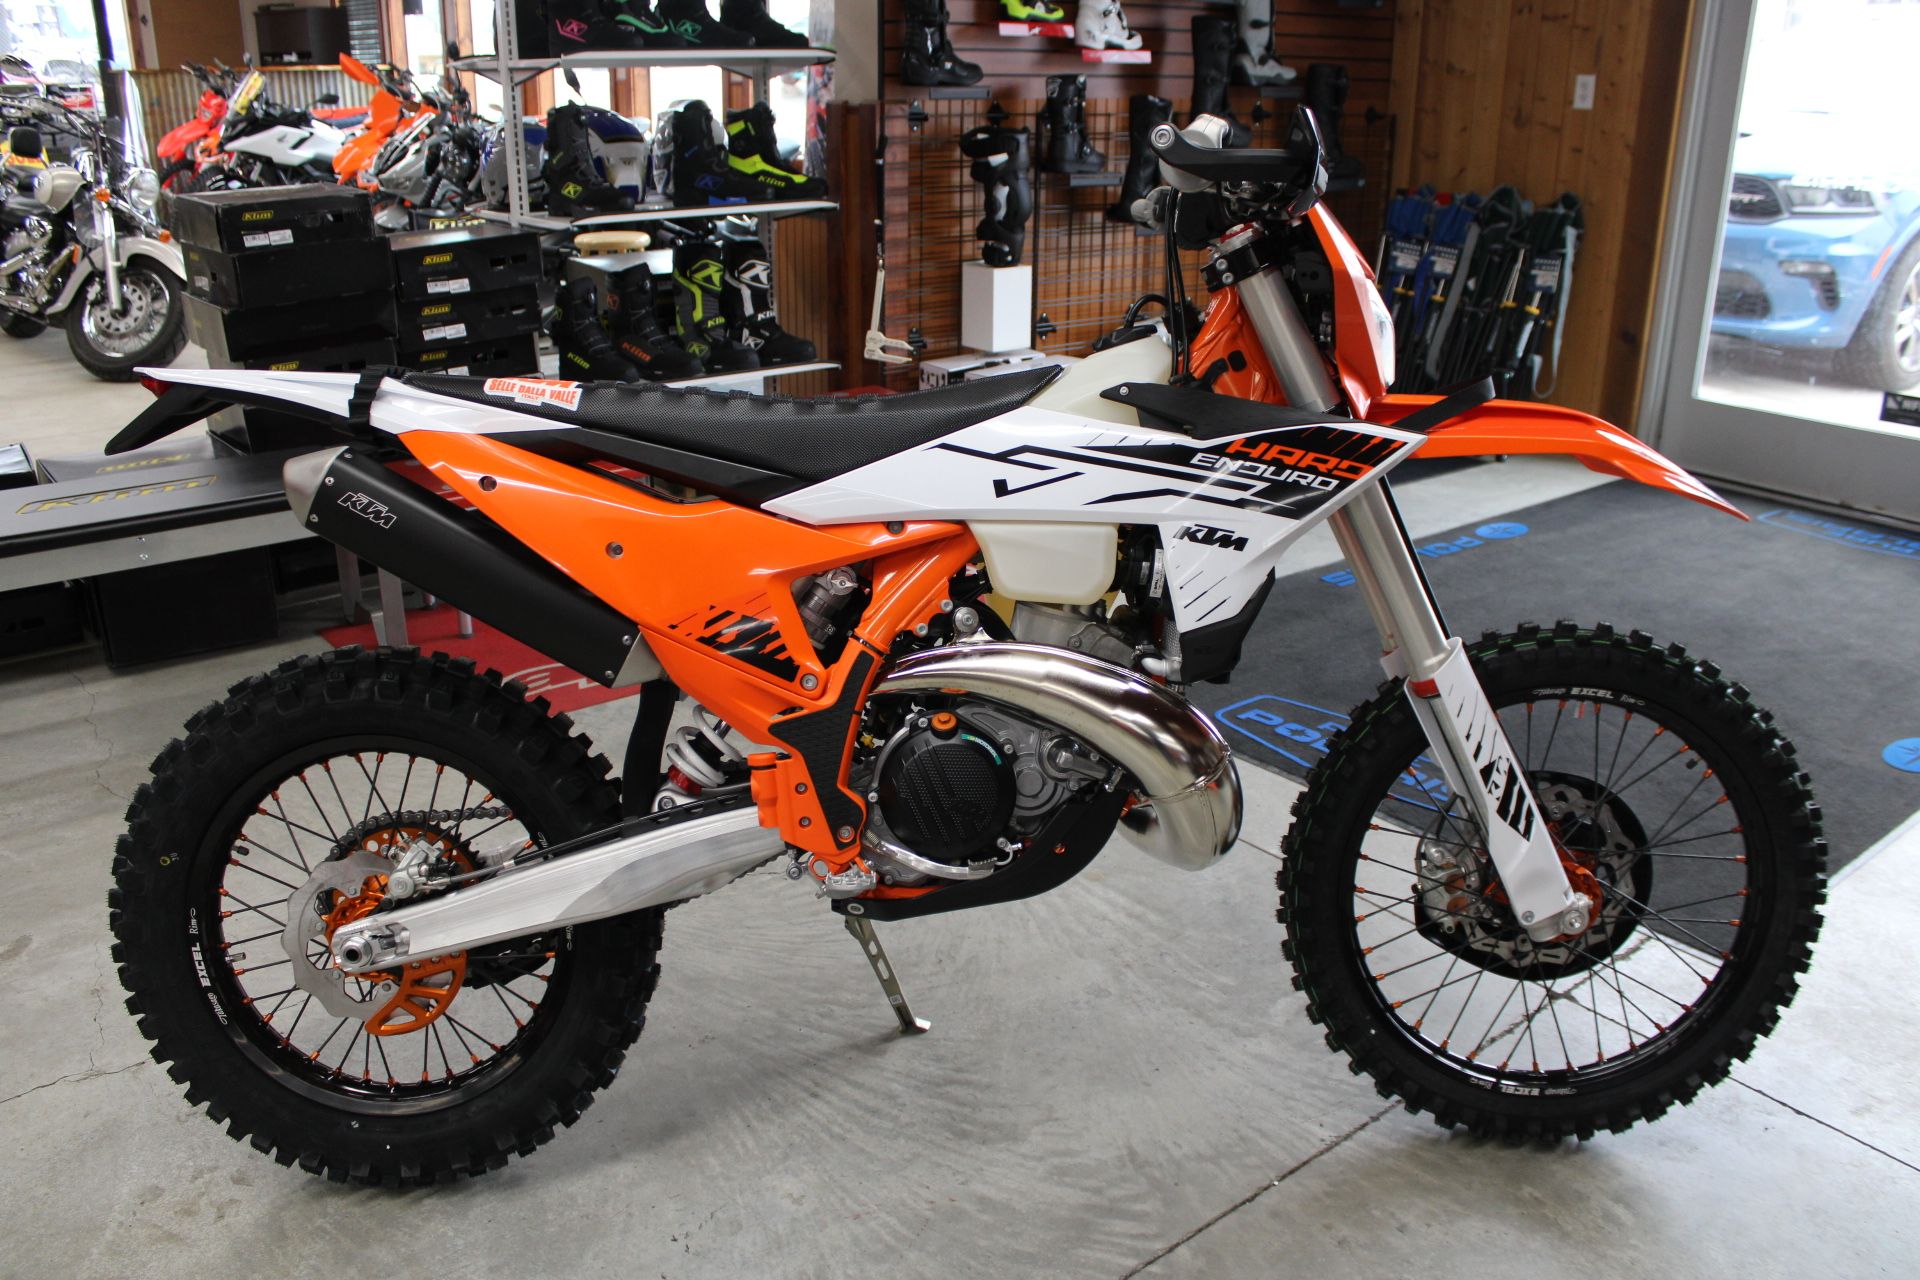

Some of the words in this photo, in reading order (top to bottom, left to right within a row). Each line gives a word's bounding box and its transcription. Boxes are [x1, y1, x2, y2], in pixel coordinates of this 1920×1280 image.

[243, 211, 274, 221] Klim
[424, 253, 452, 264] Klim
[422, 305, 451, 315] Klim
[421, 351, 447, 361] Klim
[567, 352, 590, 369] Klim
[623, 341, 652, 362] Klim
[489, 379, 517, 392] SELLE
[518, 384, 546, 398] DALLA
[549, 389, 577, 405] VALLE
[1225, 438, 1375, 480] HARD
[1189, 452, 1339, 491] ENDURO
[337, 491, 397, 529] KTM
[1173, 523, 1249, 552] KTM
[1570, 687, 1614, 699] EXCEL
[191, 942, 211, 988] EXCEL
[1500, 1084, 1541, 1096] EXCEL
